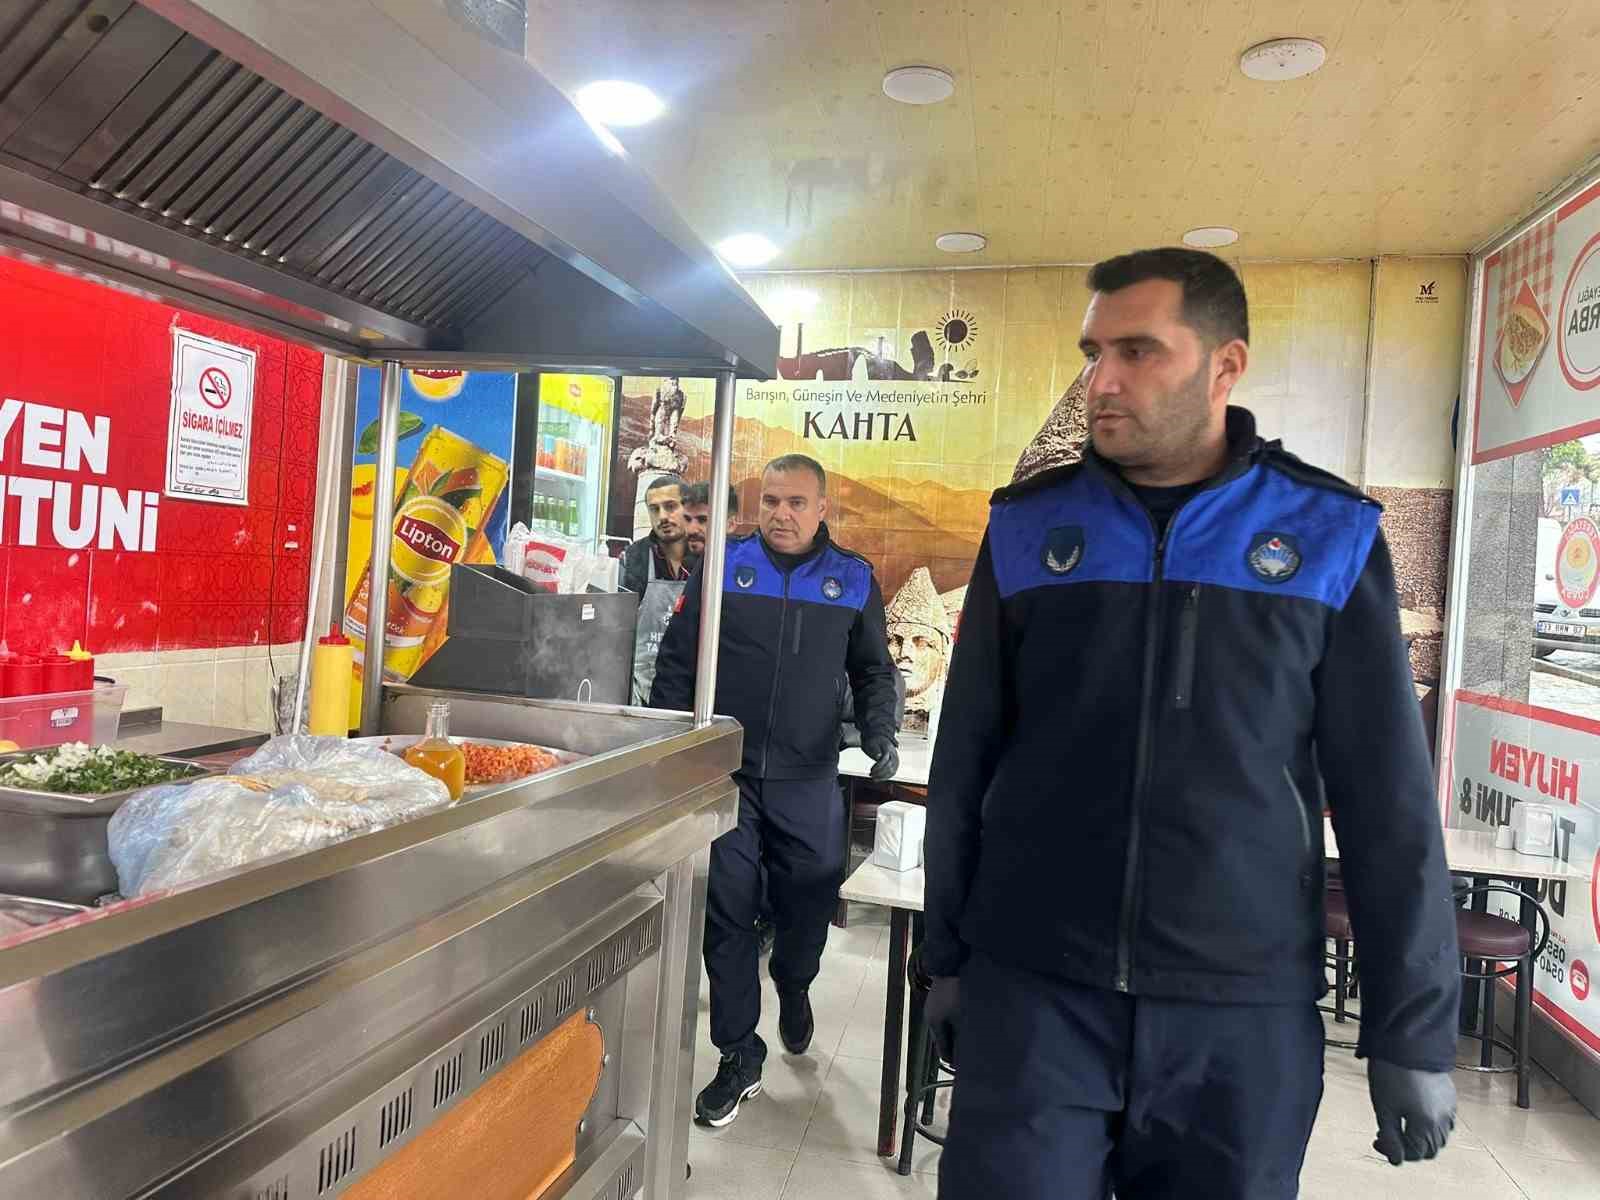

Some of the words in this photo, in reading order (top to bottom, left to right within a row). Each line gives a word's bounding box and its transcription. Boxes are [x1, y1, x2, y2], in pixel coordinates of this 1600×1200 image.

[746, 387, 790, 404] Barışın,
[793, 389, 843, 405] Güneşin
[846, 390, 863, 401] Ve
[866, 390, 949, 406] Medeniyetin
[952, 390, 986, 406] Şehri
[182, 409, 214, 432] SİGARA
[215, 414, 243, 439] İÇİLMEZ
[803, 411, 917, 442] KAHTA
[400, 519, 454, 560] Lipton
